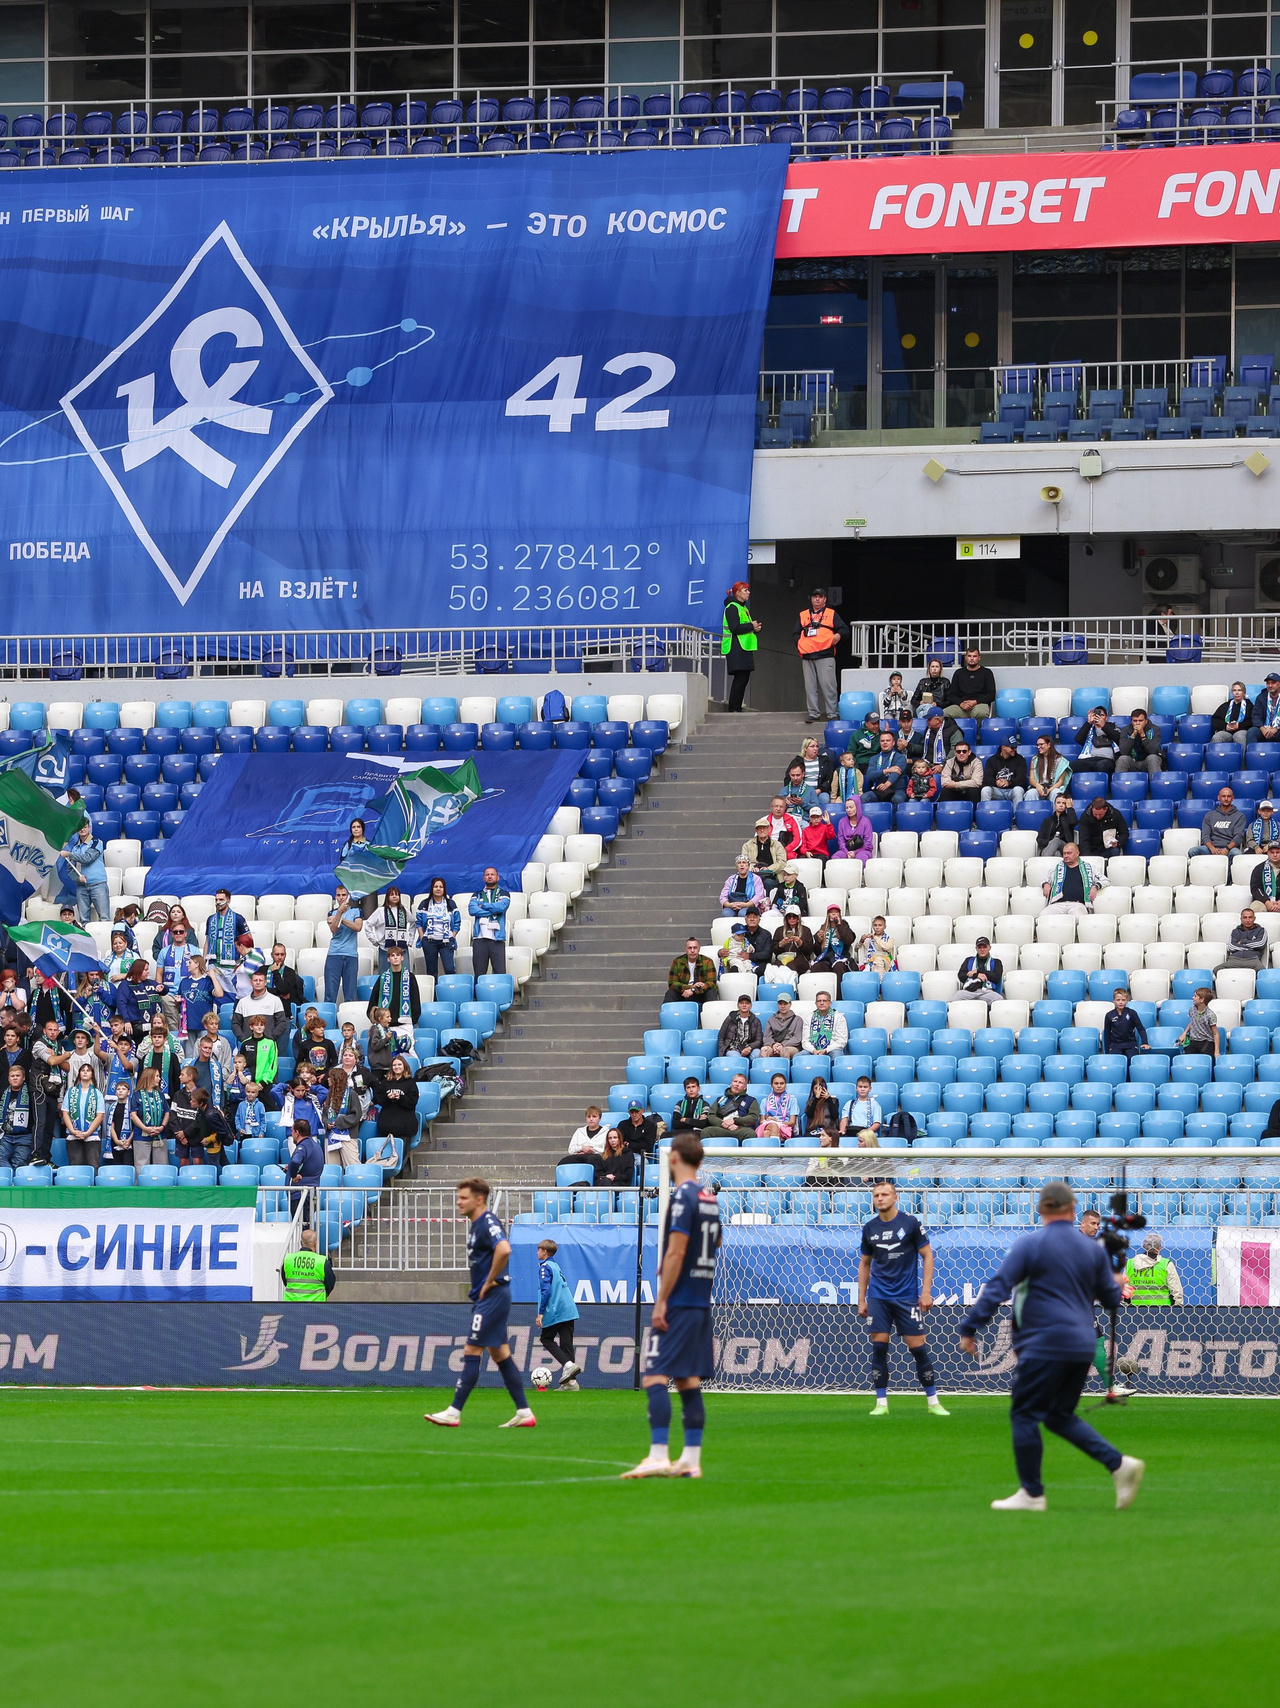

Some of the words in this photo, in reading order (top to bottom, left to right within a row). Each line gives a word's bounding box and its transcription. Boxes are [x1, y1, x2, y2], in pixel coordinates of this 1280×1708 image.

[869, 176, 1107, 230] FONBET
[1157, 168, 1280, 219] FON
[21, 204, 90, 224] ПЕРВЫЙ
[99, 206, 135, 222] ШАГ
[312, 213, 467, 240] «КРЫЛЬЯ»
[526, 211, 588, 238] ЭТО
[606, 207, 728, 235] КОСМОС
[504, 349, 678, 433] 42
[9, 541, 91, 562] ПОБЕДА
[449, 542, 661, 572] 53.278412°
[687, 539, 707, 567] N
[977, 543, 998, 556] 114
[239, 581, 265, 600] НА
[279, 576, 360, 600] ВЗЛЁТ!
[448, 582, 661, 612] 50.236081°
[686, 580, 705, 607] E
[292, 1256, 316, 1269] 10568
[472, 1314, 482, 1332] 8
